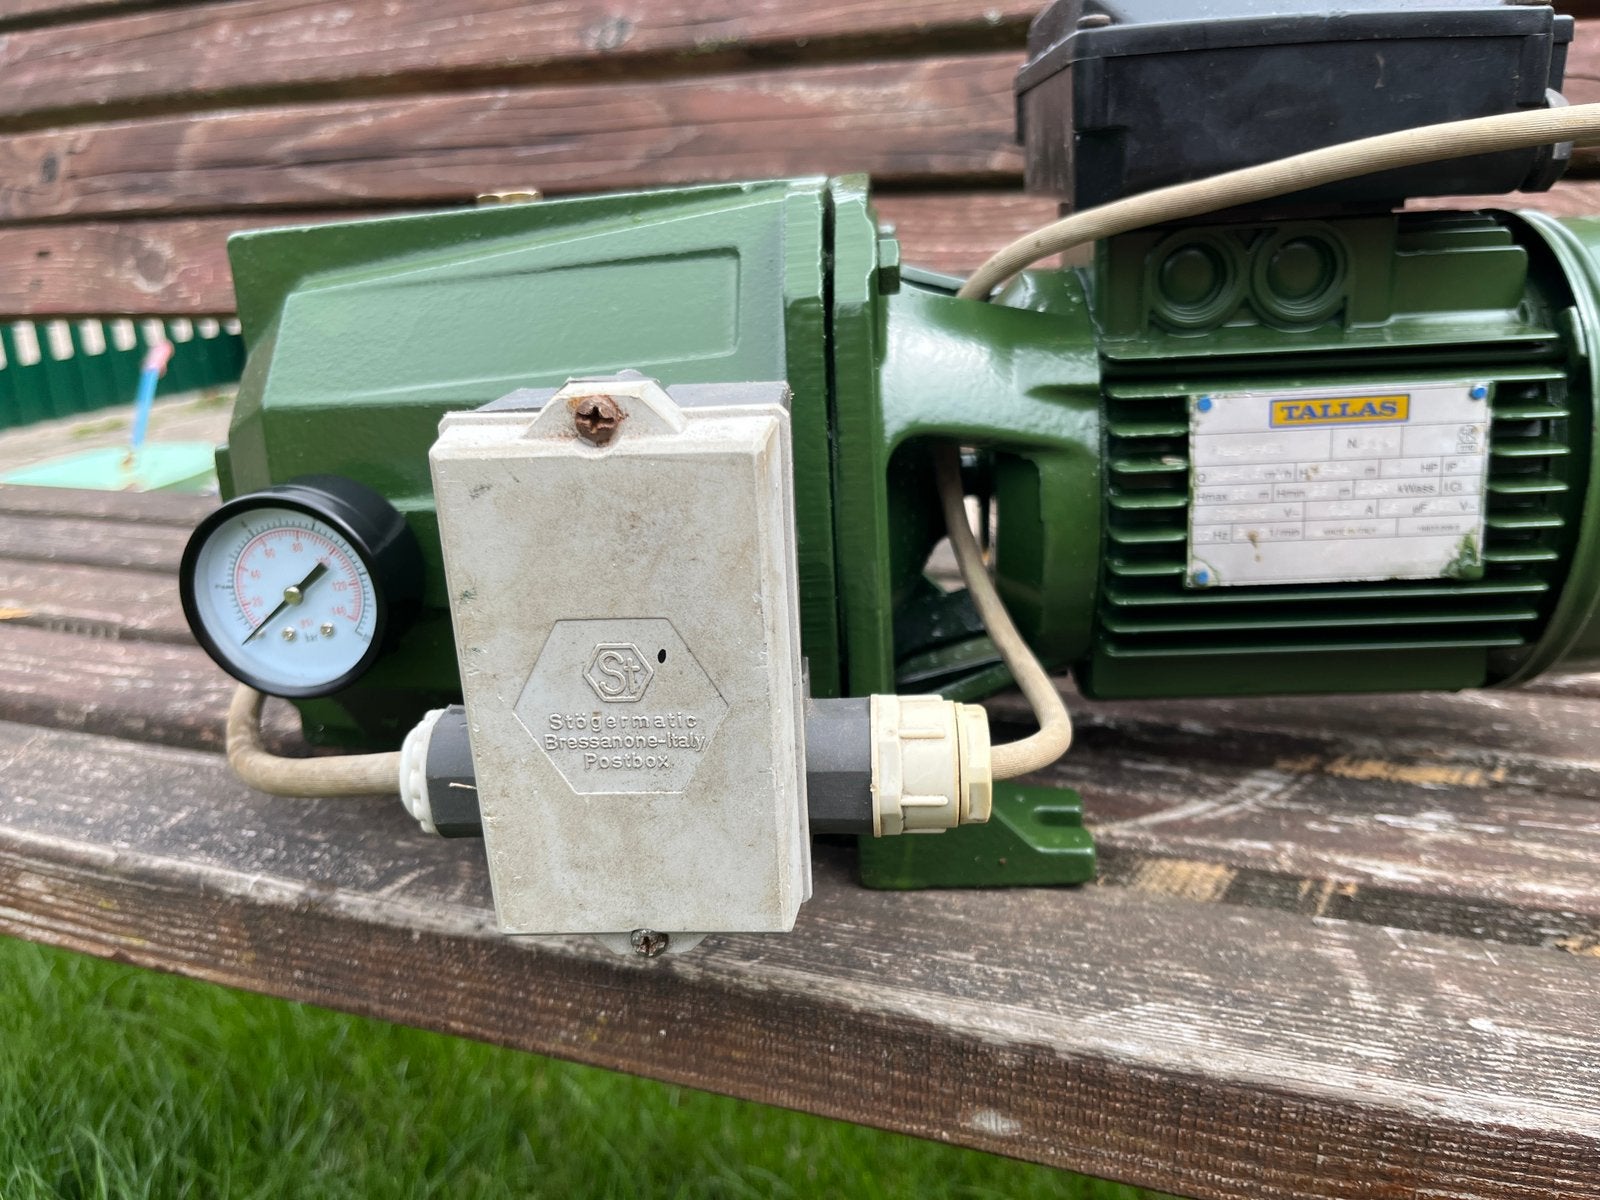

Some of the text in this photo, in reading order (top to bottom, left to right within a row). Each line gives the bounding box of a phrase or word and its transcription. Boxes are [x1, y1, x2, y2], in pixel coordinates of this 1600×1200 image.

[1280, 400, 1397, 421] TALLAS
[599, 650, 641, 695] St
[549, 711, 698, 732] Stögermatic
[583, 751, 671, 770] Postbox
